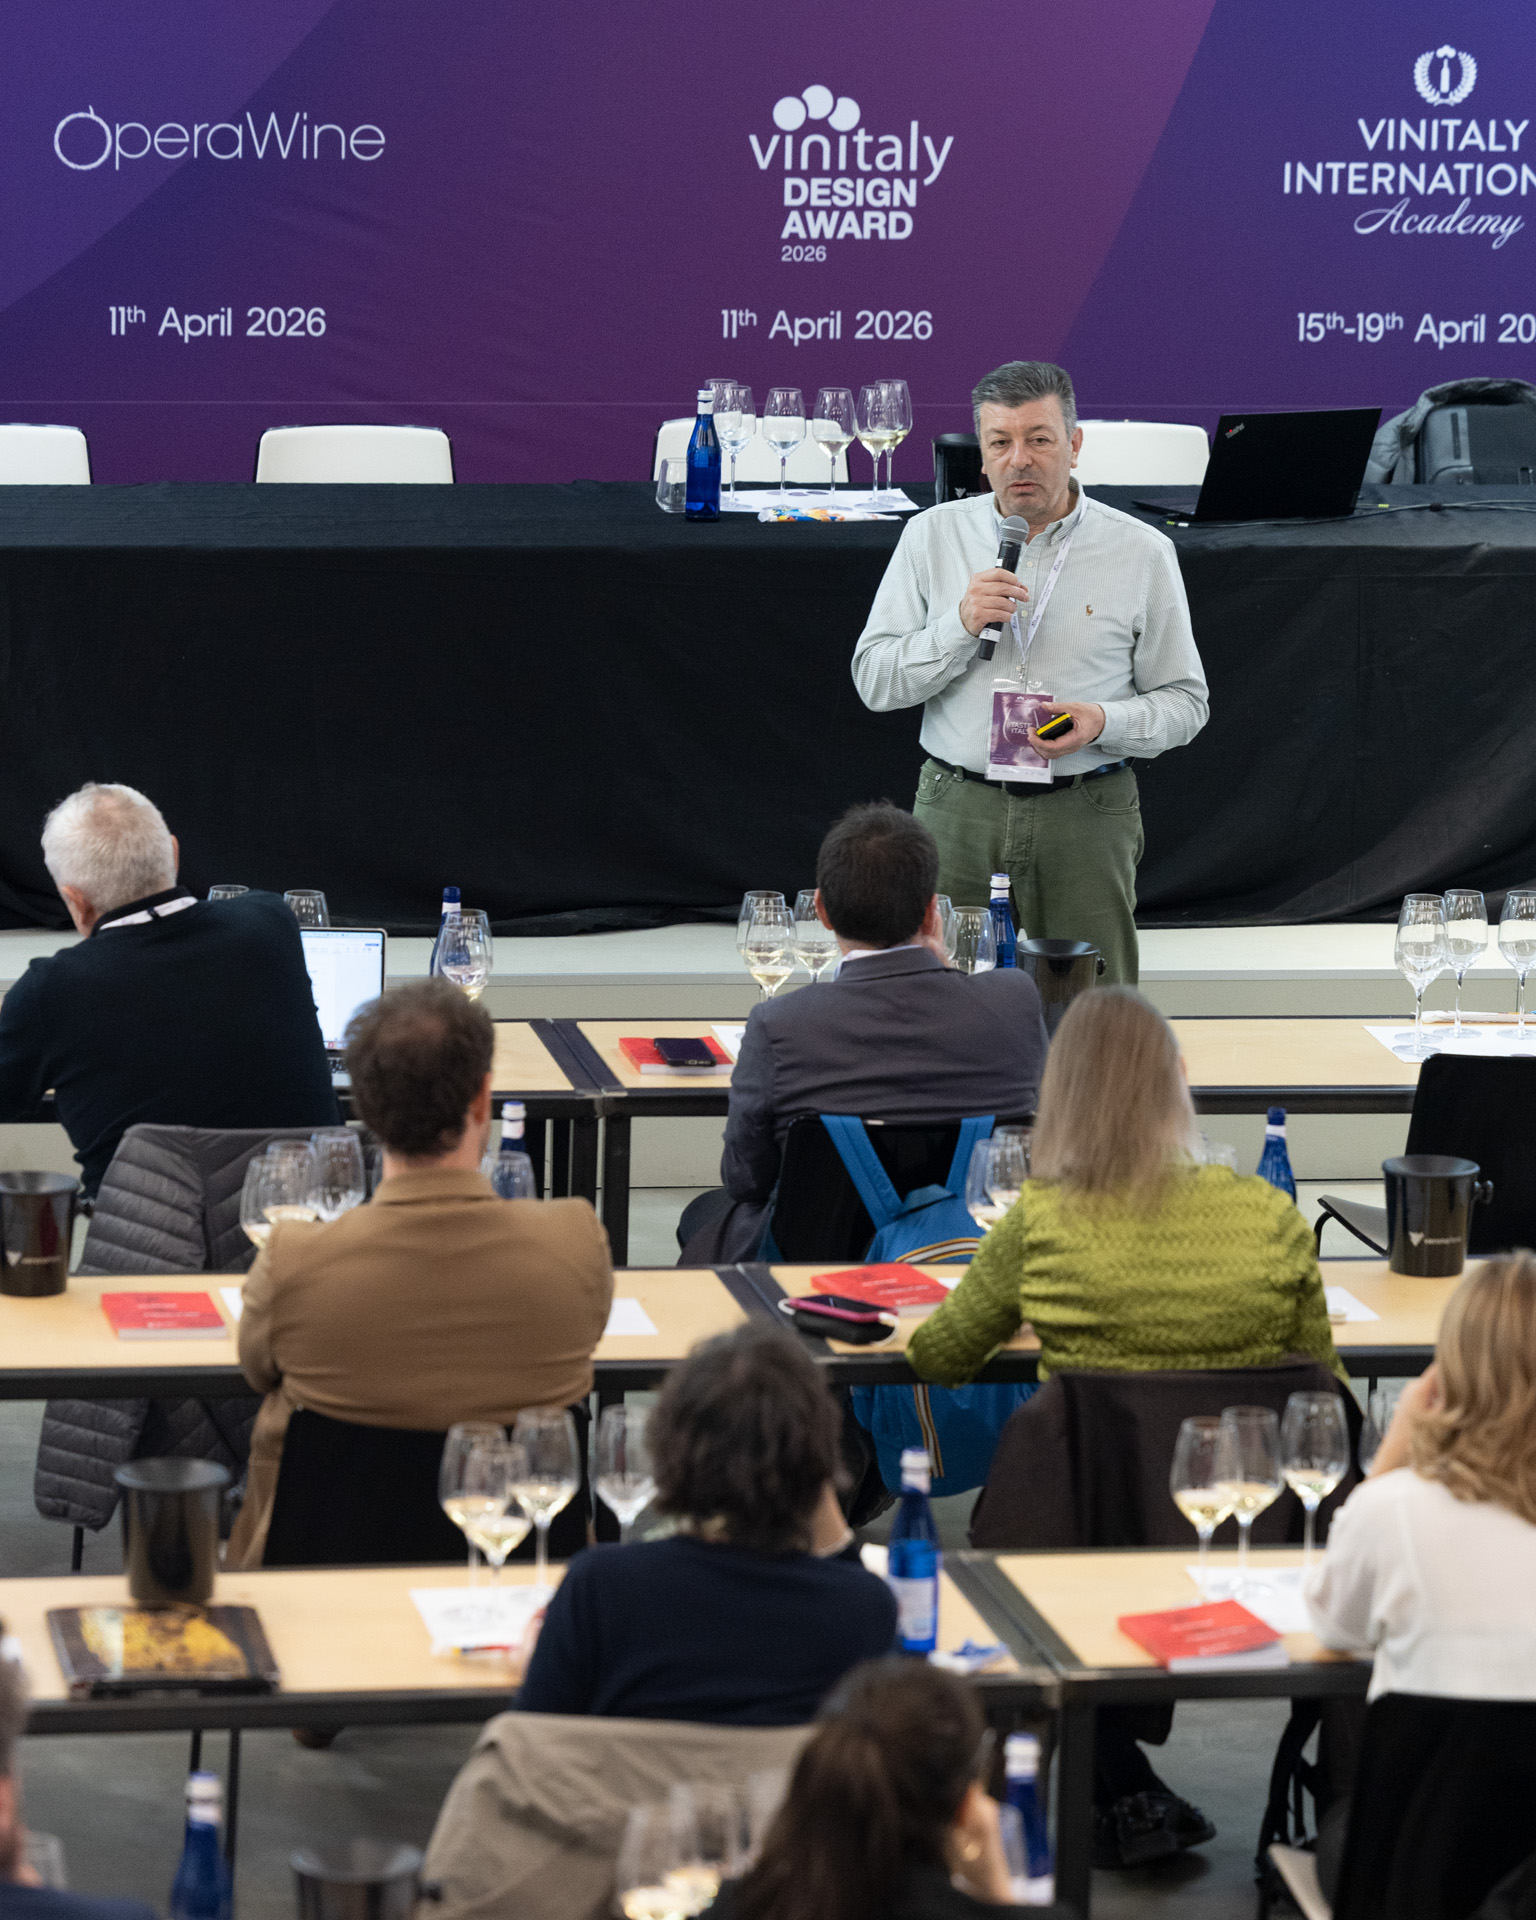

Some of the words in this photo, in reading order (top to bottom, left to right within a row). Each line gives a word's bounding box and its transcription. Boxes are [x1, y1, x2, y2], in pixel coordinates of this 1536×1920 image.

[53, 105, 387, 171] OperaWine
[749, 119, 955, 187] vinitaly
[1357, 118, 1529, 152] VINITALY
[783, 177, 918, 208] DESIGN
[781, 210, 914, 240] AWARD
[1354, 197, 1522, 249] Academy
[781, 245, 827, 262] 2026
[110, 306, 146, 336] 11th
[158, 307, 233, 343] April
[246, 306, 327, 337] 2026
[720, 309, 757, 339] 11th
[768, 310, 842, 347] April
[854, 310, 934, 340] 2026
[1297, 312, 1404, 343] 15th-19th
[1414, 313, 1486, 350] April
